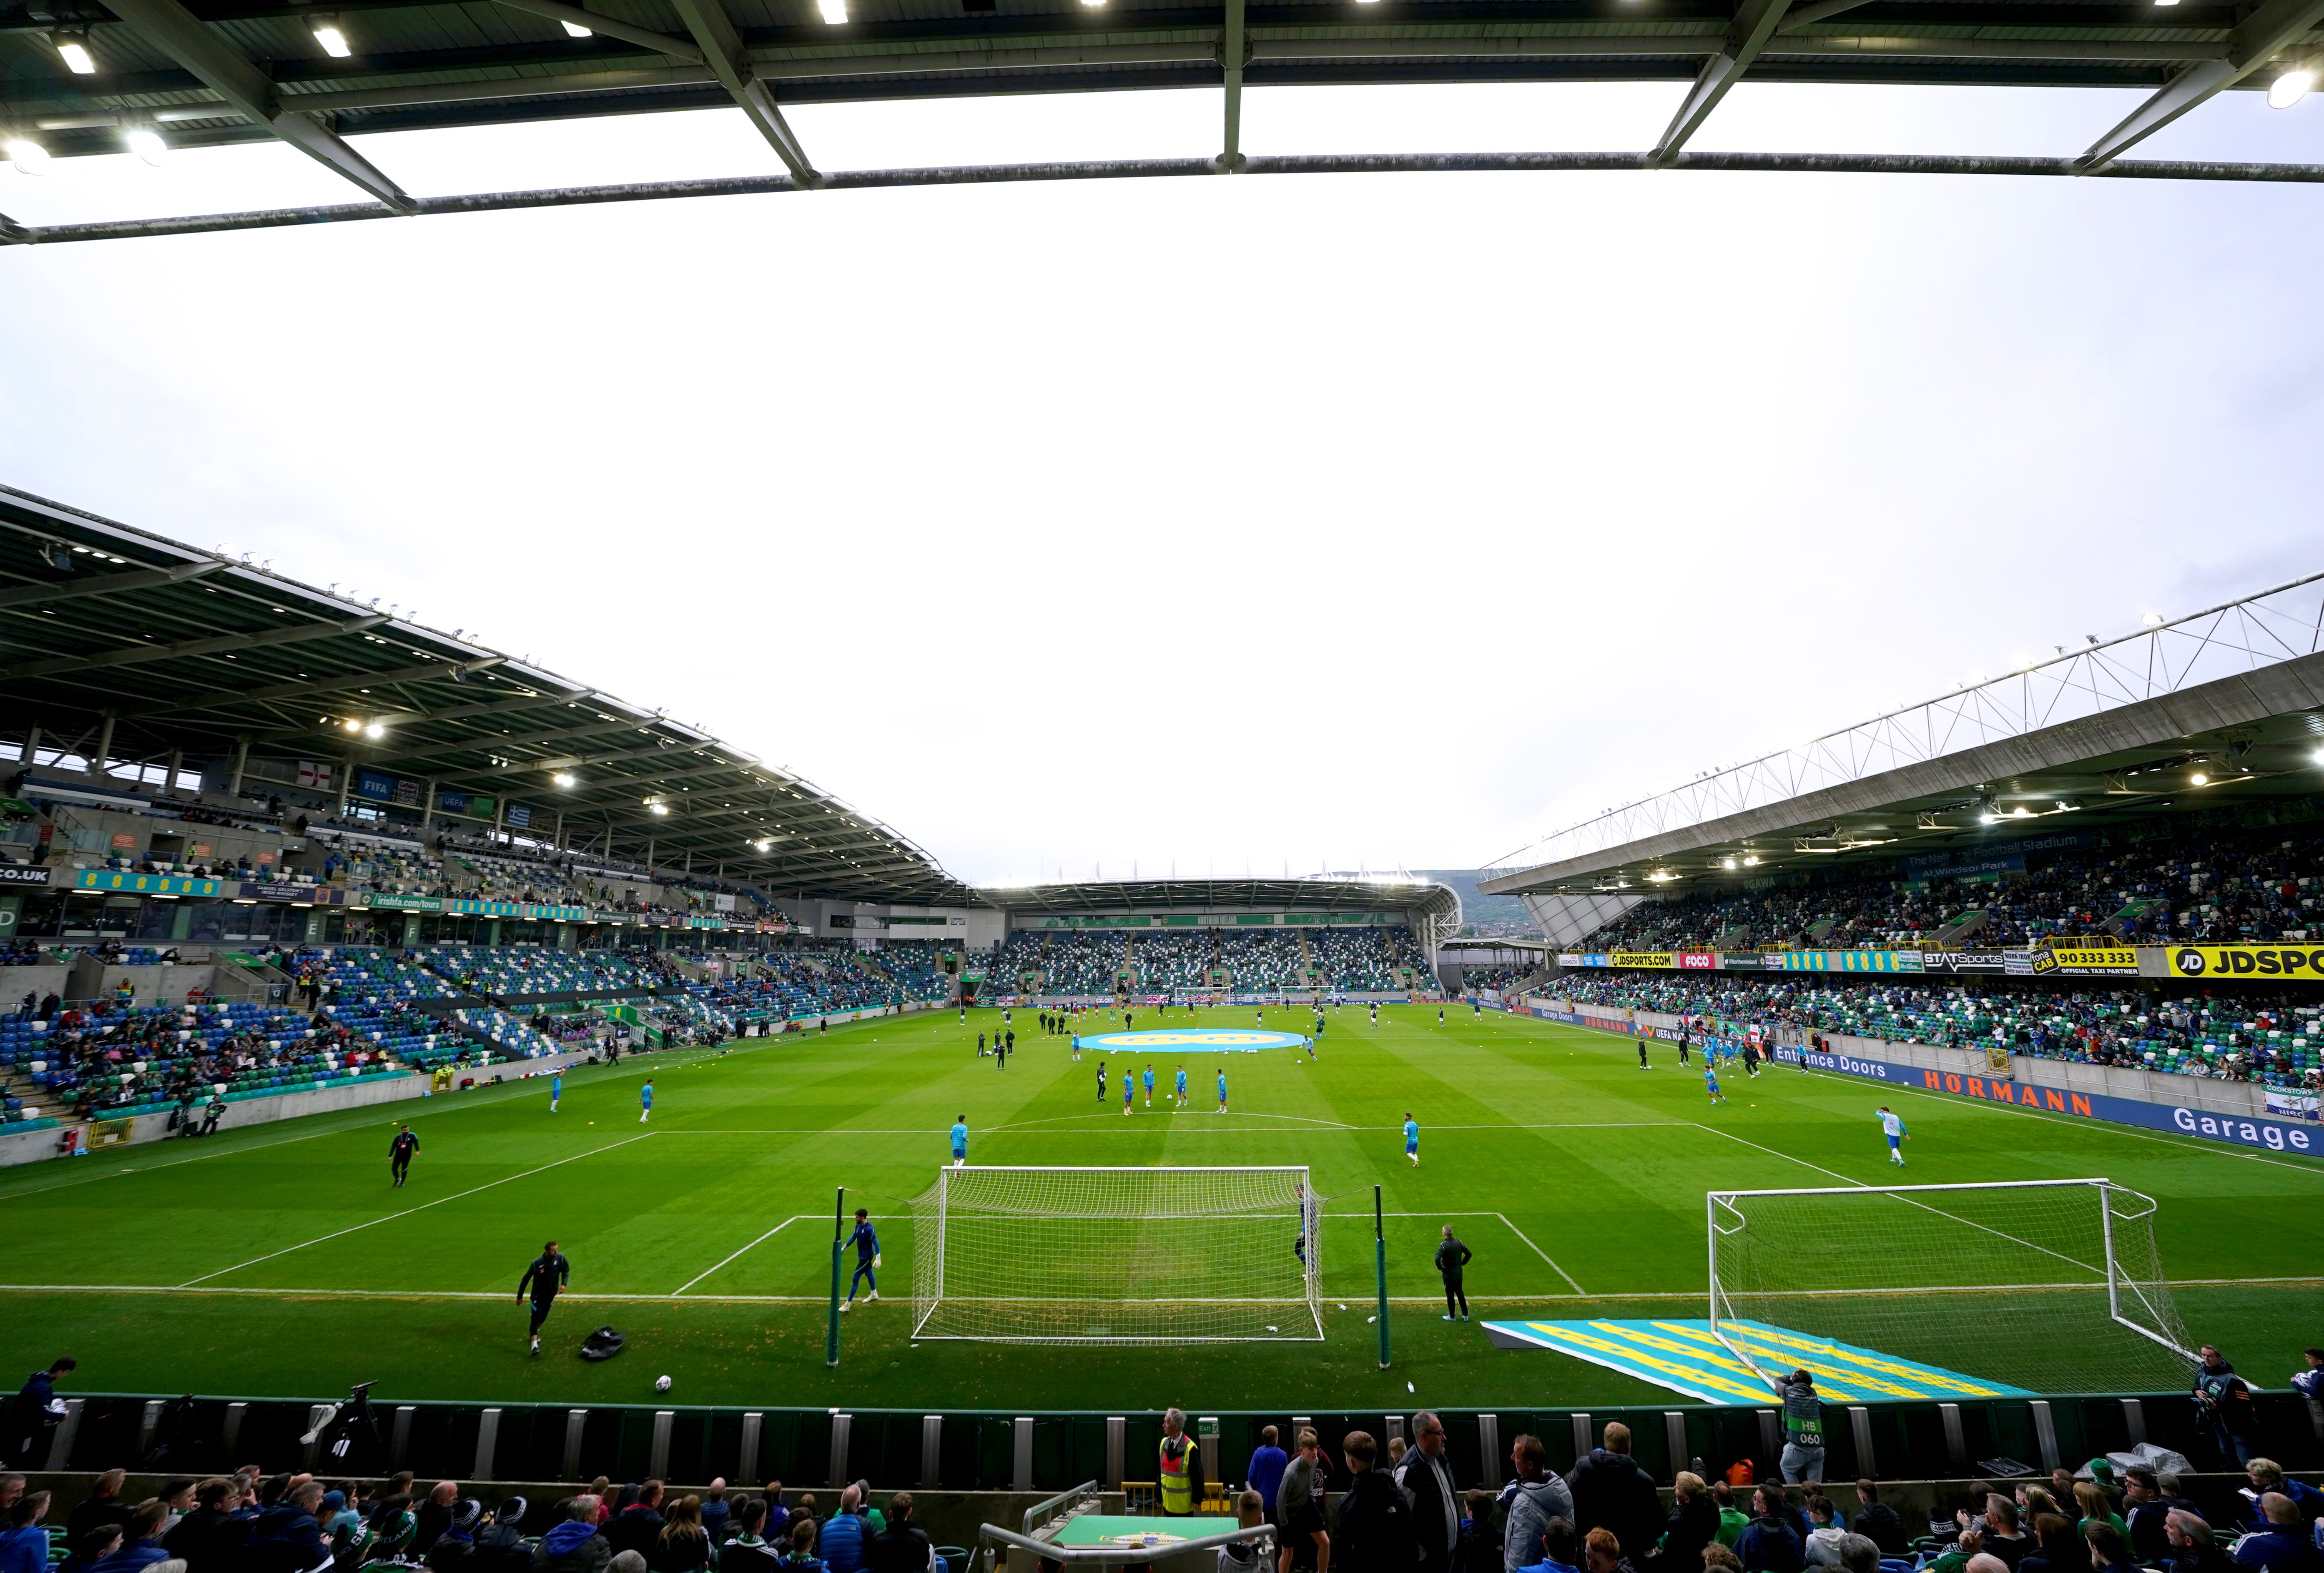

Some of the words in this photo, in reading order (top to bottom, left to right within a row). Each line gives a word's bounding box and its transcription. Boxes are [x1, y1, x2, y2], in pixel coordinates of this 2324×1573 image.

[364, 780, 387, 794] FIFA
[444, 798, 464, 807] UEFA
[1909, 857, 1927, 866] The
[1929, 849, 1970, 863] Natial
[1974, 842, 2020, 856] Football
[2023, 836, 2077, 850] Stadium
[1935, 865, 1979, 875] Windsor
[1981, 861, 2008, 871] Park
[1743, 877, 1776, 889] #GAWA
[377, 896, 439, 909] irishfa.com/tours
[1198, 916, 1219, 924] NORTHERN
[1220, 916, 1237, 924] IRELAND
[309, 923, 317, 935] E
[409, 928, 416, 938] F
[560, 933, 565, 942] F
[615, 936, 620, 944] G
[1619, 956, 1671, 966] JDSPORTS.COM
[1685, 955, 1709, 967] FOCO
[1924, 951, 2003, 964] STATSports
[2031, 951, 2049, 962] fona
[2059, 953, 2078, 963] 90
[2079, 953, 2105, 963] 333
[2108, 953, 2135, 963] 333
[2181, 955, 2202, 969] JD
[2034, 958, 2054, 971] CAB
[1542, 1009, 1558, 1020] Garage
[1559, 1012, 1573, 1021] Doors
[1586, 1017, 1628, 1033] HÖRMANN
[1656, 1029, 1671, 1039] UEFA
[1672, 1031, 1702, 1046] NATONS
[1840, 1056, 1885, 1077] Doors
[1925, 1070, 2092, 1116] HÖRMANN
[2267, 1085, 2312, 1095] COOKSTOWN
[2174, 1108, 2309, 1150] Garage
[1802, 1420, 1816, 1431] HB
[1800, 1433, 1820, 1444] 060
